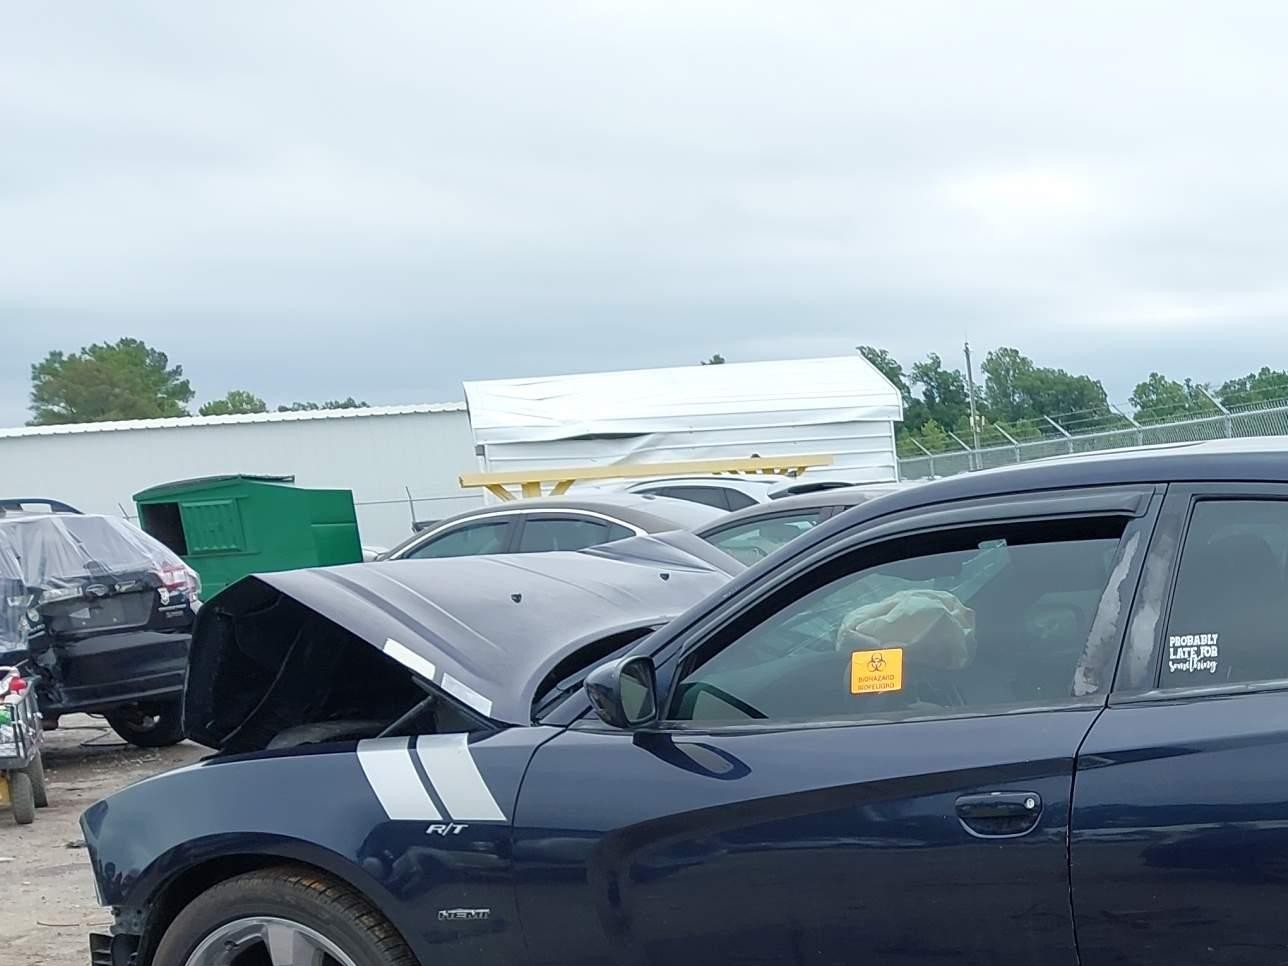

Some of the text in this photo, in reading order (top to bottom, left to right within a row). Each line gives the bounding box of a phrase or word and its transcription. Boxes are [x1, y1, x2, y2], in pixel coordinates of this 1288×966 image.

[1169, 633, 1218, 647] PROBABLY
[1169, 645, 1218, 660] LATE FOR
[1168, 656, 1218, 673] something
[858, 674, 895, 684] BIOHAZARD
[426, 822, 469, 836] R/T
